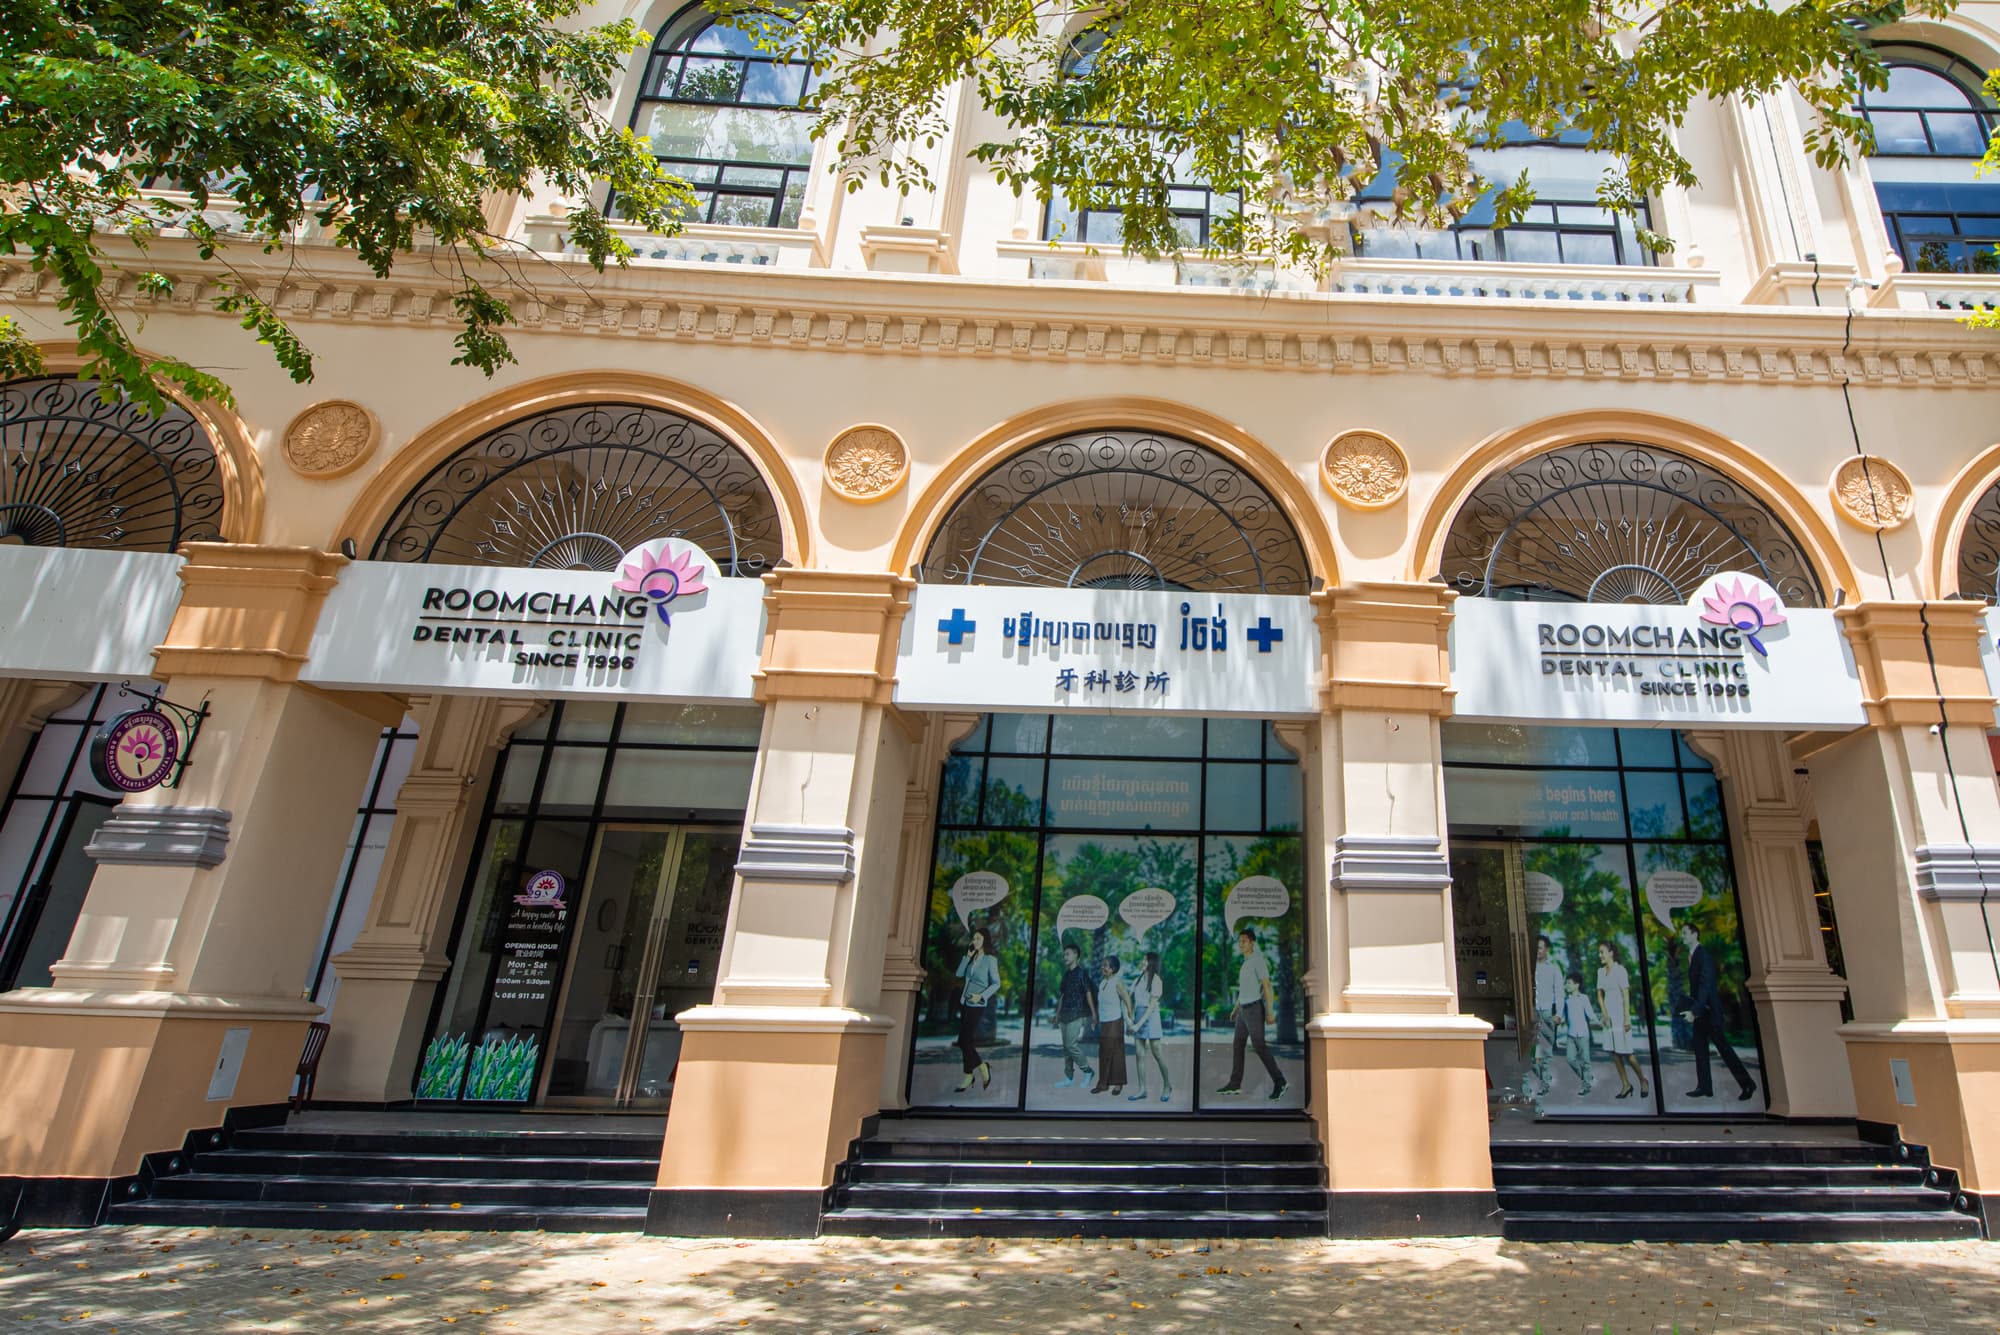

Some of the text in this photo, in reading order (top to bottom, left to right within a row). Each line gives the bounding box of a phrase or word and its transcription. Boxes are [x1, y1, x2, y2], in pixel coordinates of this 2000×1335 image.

[422, 587, 649, 618] ROOMCHANG
[413, 625, 642, 650] DENTAL CLINIC
[1537, 623, 1743, 650] ROOMCHANG
[514, 652, 635, 670] SINCE 1996
[1541, 659, 1746, 679] DENTAL CLINIC
[1055, 668, 1171, 695] 牙科診所
[1640, 681, 1750, 697] SINCE 1996
[122, 779, 146, 787] DENTAL
[147, 756, 171, 783] HOSPITAL
[1545, 784, 1587, 805] begins
[1588, 786, 1617, 803] here
[507, 960, 526, 969] Mon
[533, 961, 548, 969] Sat
